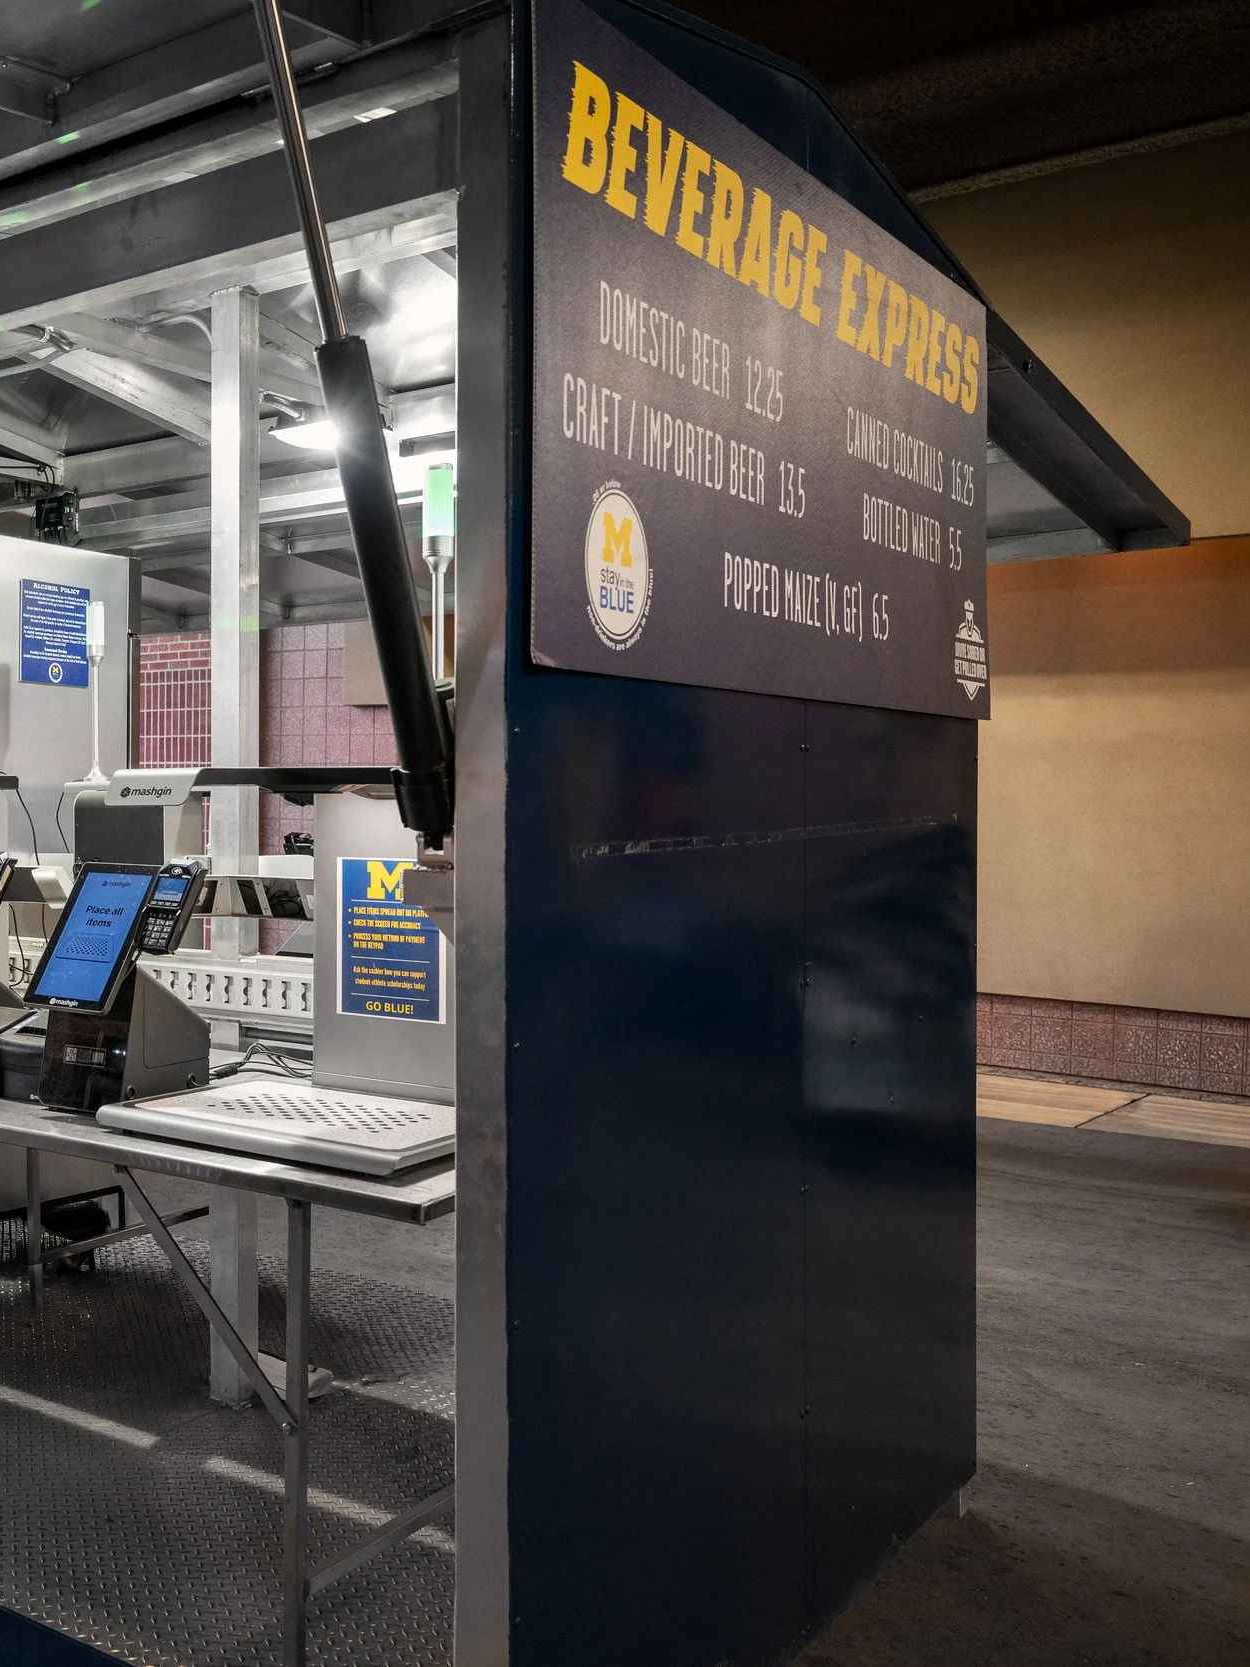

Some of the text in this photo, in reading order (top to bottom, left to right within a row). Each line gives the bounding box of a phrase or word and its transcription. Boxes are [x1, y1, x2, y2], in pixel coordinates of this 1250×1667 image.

[561, 59, 980, 414] BEVERAGE EXPRESS
[600, 280, 783, 422] DOMESTIC BEER 12.25
[563, 373, 806, 519] CRAFT / IMPORTED BEER 13.5
[847, 406, 974, 507] CANNED COCKTAILS 16.25
[863, 493, 962, 571] BOTTLED WATER 5.5
[602, 511, 633, 568] M
[600, 565, 620, 590] stay
[33, 582, 80, 595] ALCOHOL POLICY
[600, 585, 634, 614] BLUE
[724, 551, 889, 642] POPPED MAIZE (V, GF) 6.5
[625, 626, 642, 648] always
[131, 786, 172, 798] mashgin
[367, 861, 414, 900] M
[85, 905, 124, 916] Place all
[353, 906, 366, 914] PLACE
[366, 907, 379, 915] ITEMS
[379, 908, 396, 916] SPREAD
[396, 908, 405, 916] OUT
[405, 909, 412, 917] ON
[85, 918, 112, 928] items
[353, 918, 421, 930] CHECK THE SCREEN FOR ACCURACY
[353, 932, 426, 944] PROCESS YOUR METHOD OF PAYMENT
[359, 941, 368, 949] THE
[368, 967, 384, 975] cashier
[409, 971, 427, 979] support
[354, 978, 426, 991] student-athlete scholarships today
[55, 999, 79, 1007] mashgin
[365, 1001, 414, 1015] GO BLUE!
